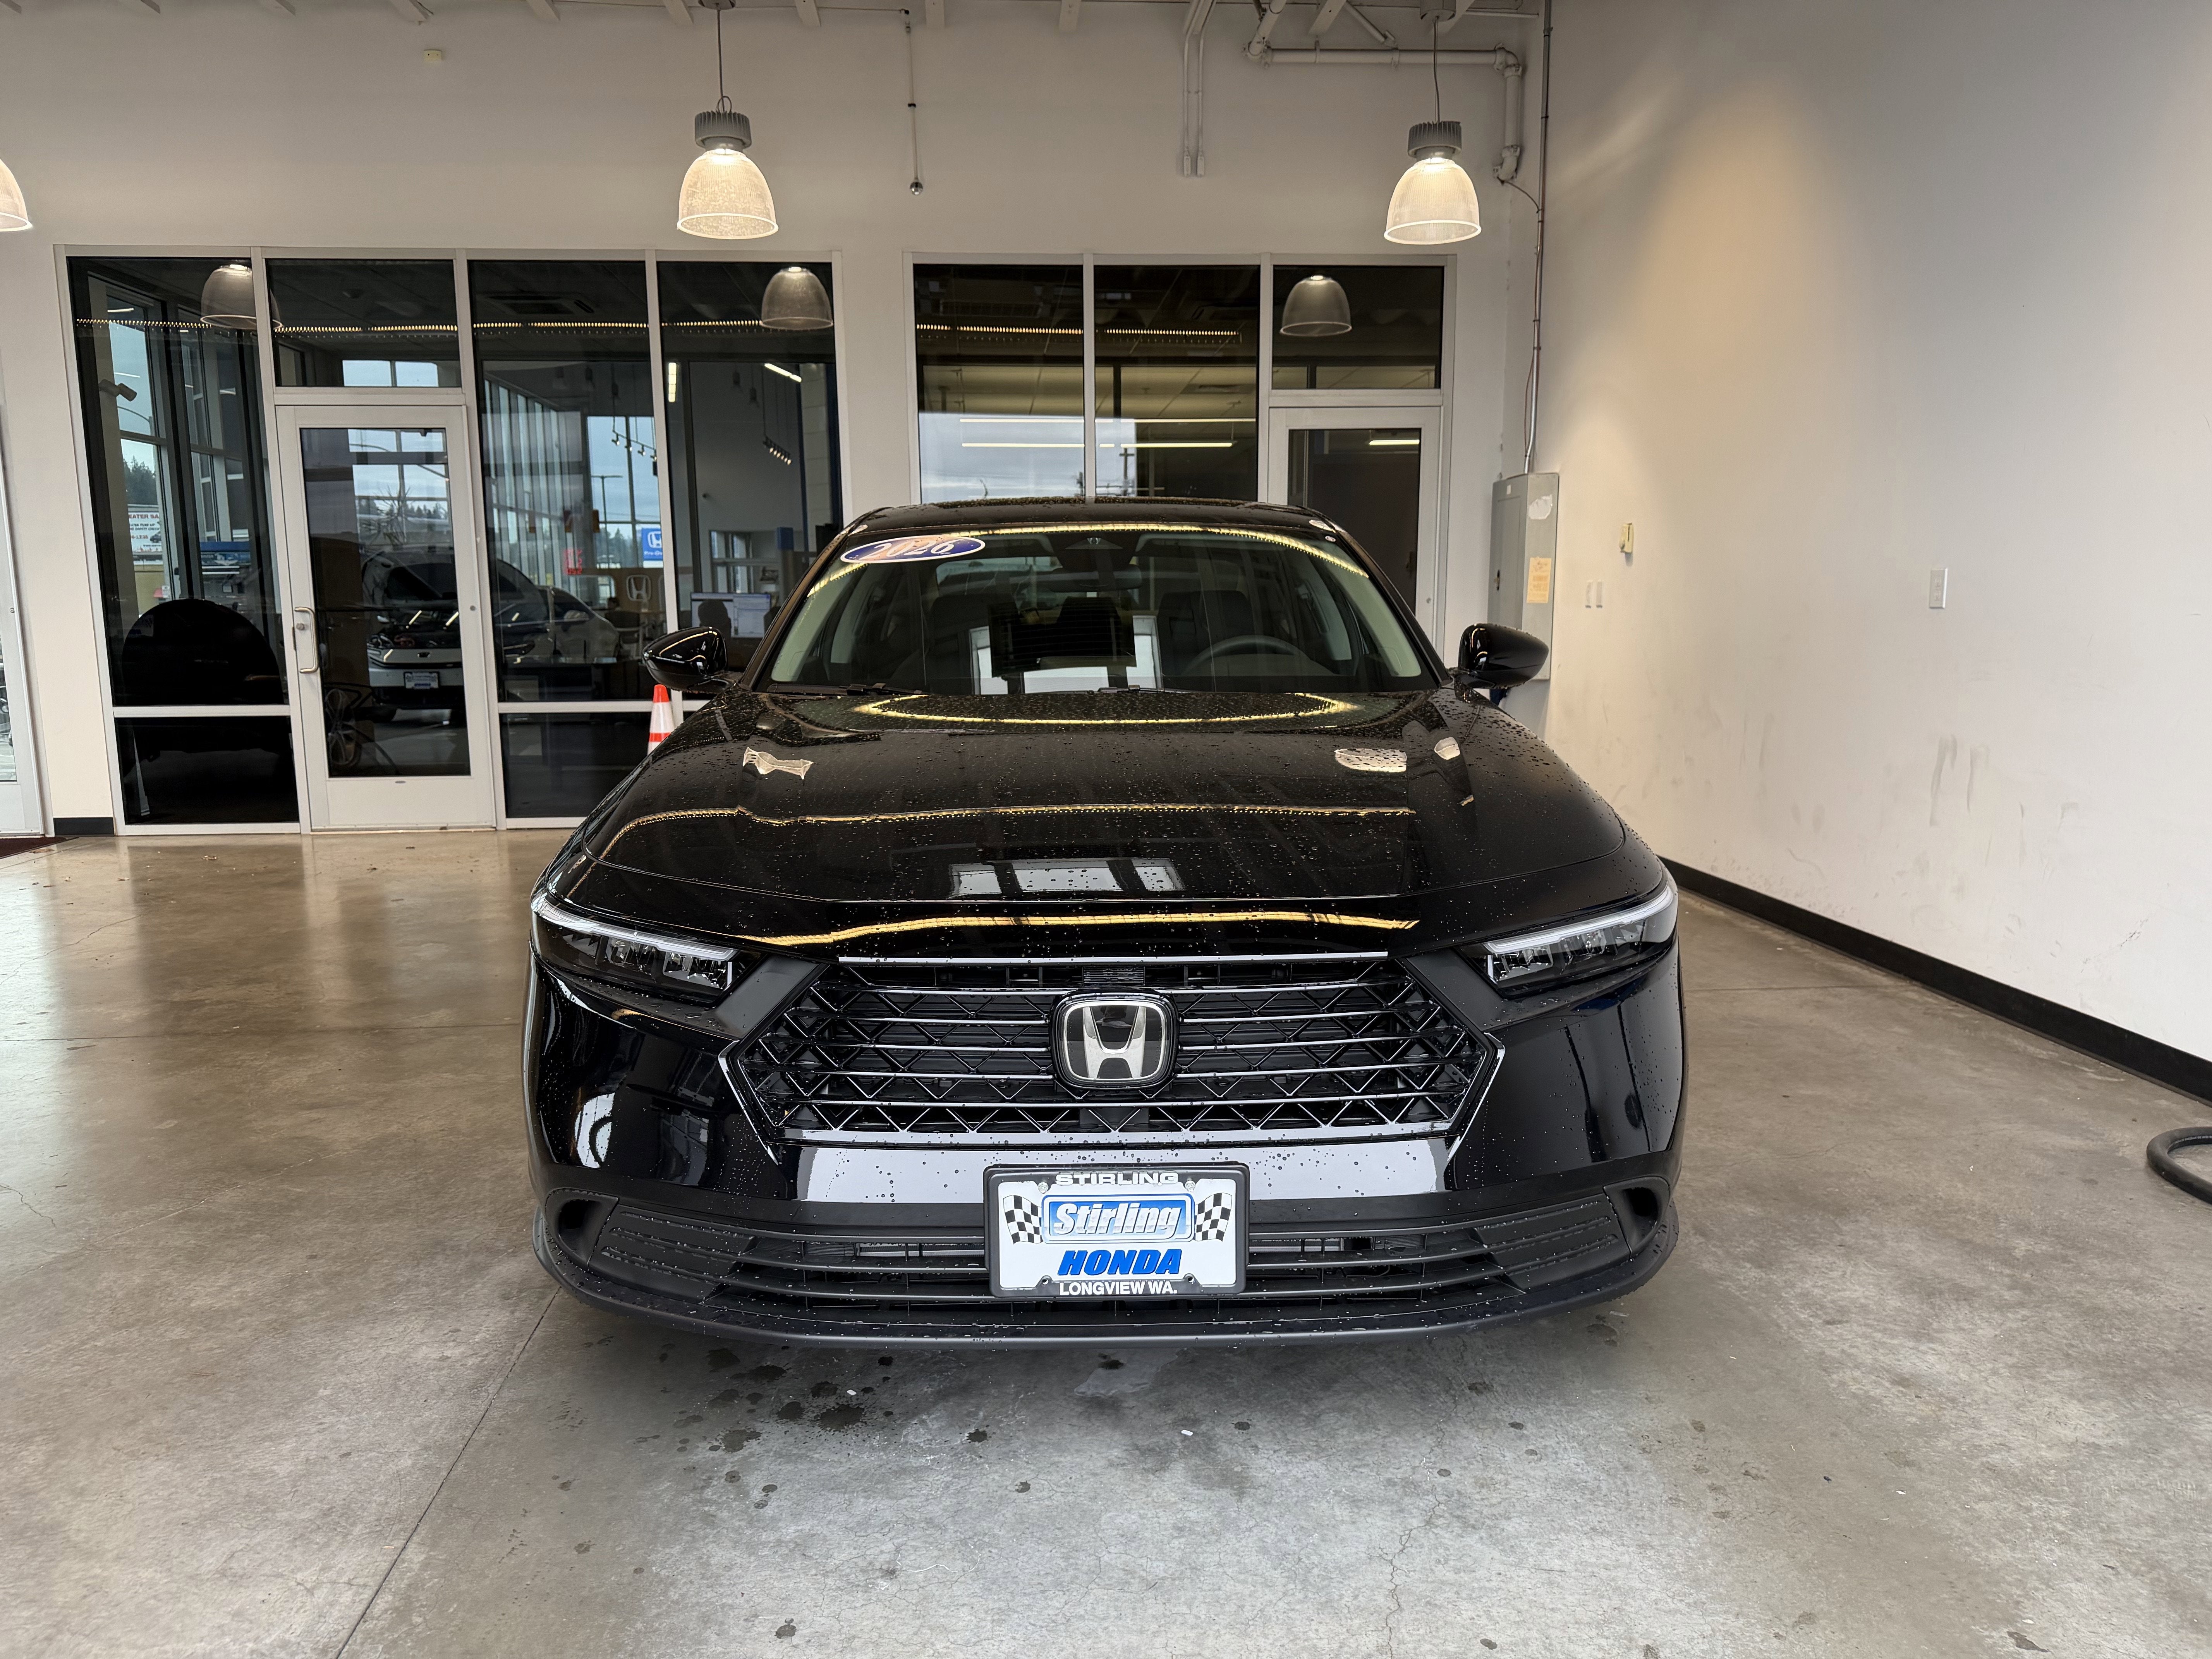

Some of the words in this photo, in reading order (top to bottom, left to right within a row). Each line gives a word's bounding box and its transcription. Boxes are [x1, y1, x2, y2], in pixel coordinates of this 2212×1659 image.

[859, 539, 965, 560] 2026
[1056, 1172, 1178, 1185] STIRLING
[1053, 1202, 1182, 1239] Stirling
[1057, 1249, 1182, 1275] HONDA
[1059, 1281, 1146, 1295] LONGVIEW
[1148, 1281, 1177, 1294] WA.
